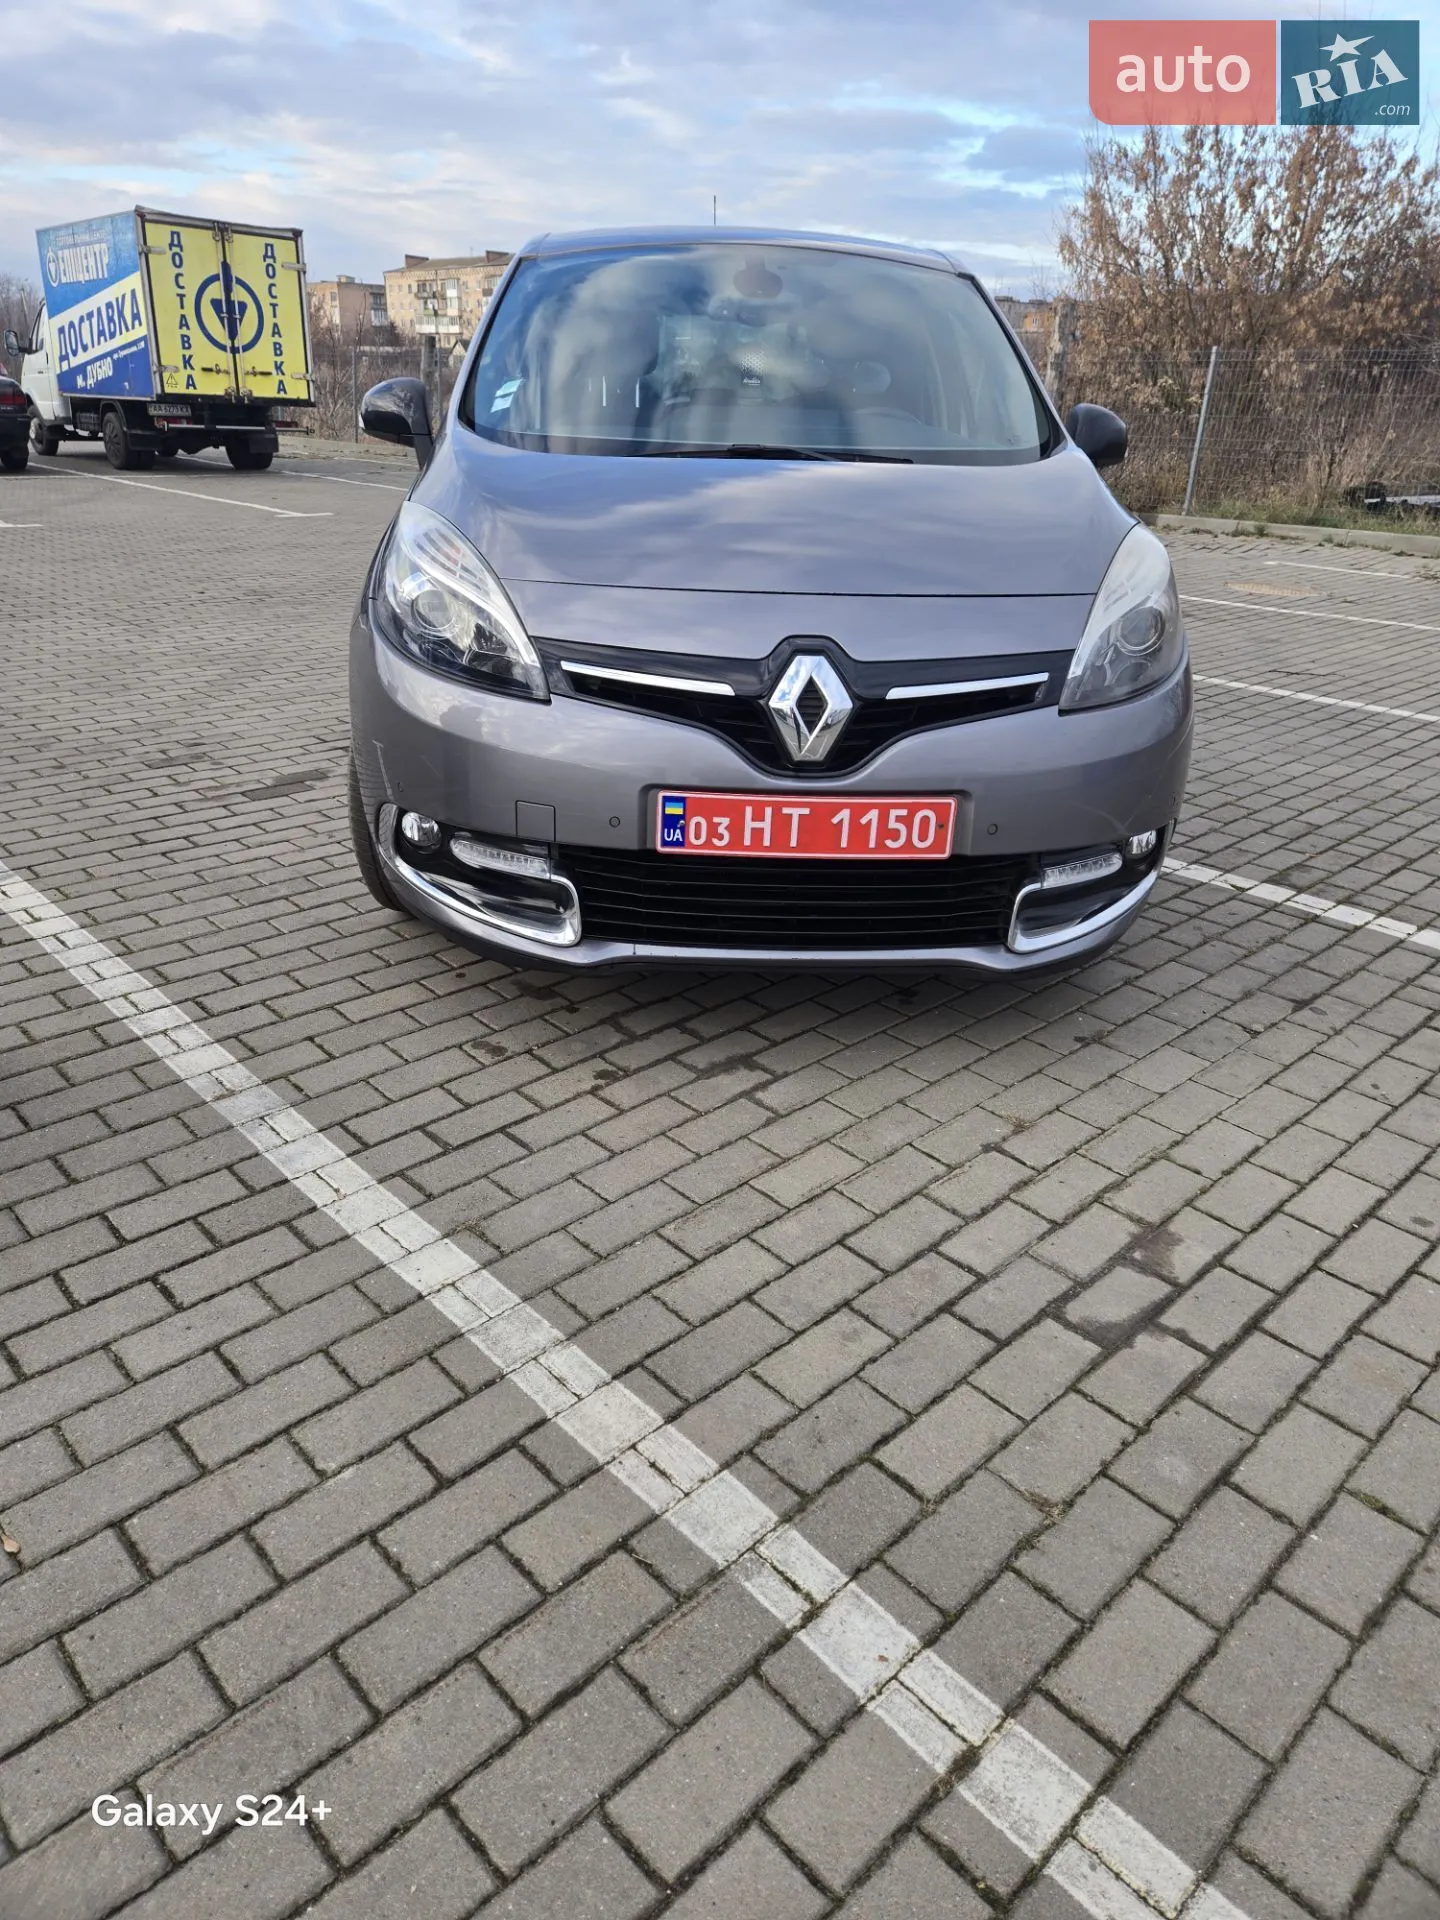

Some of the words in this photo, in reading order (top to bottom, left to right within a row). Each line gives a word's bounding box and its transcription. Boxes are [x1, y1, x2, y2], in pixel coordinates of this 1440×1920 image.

[57, 288, 142, 372] ДОСТАВКА
[168, 230, 197, 390] ДОСТАВКА
[263, 243, 287, 395] ДОСТАВКА
[86, 357, 113, 389] ДУБНО
[664, 828, 683, 842] UA
[688, 816, 731, 846] 03
[743, 805, 810, 848] HT
[830, 808, 936, 849] 1150
